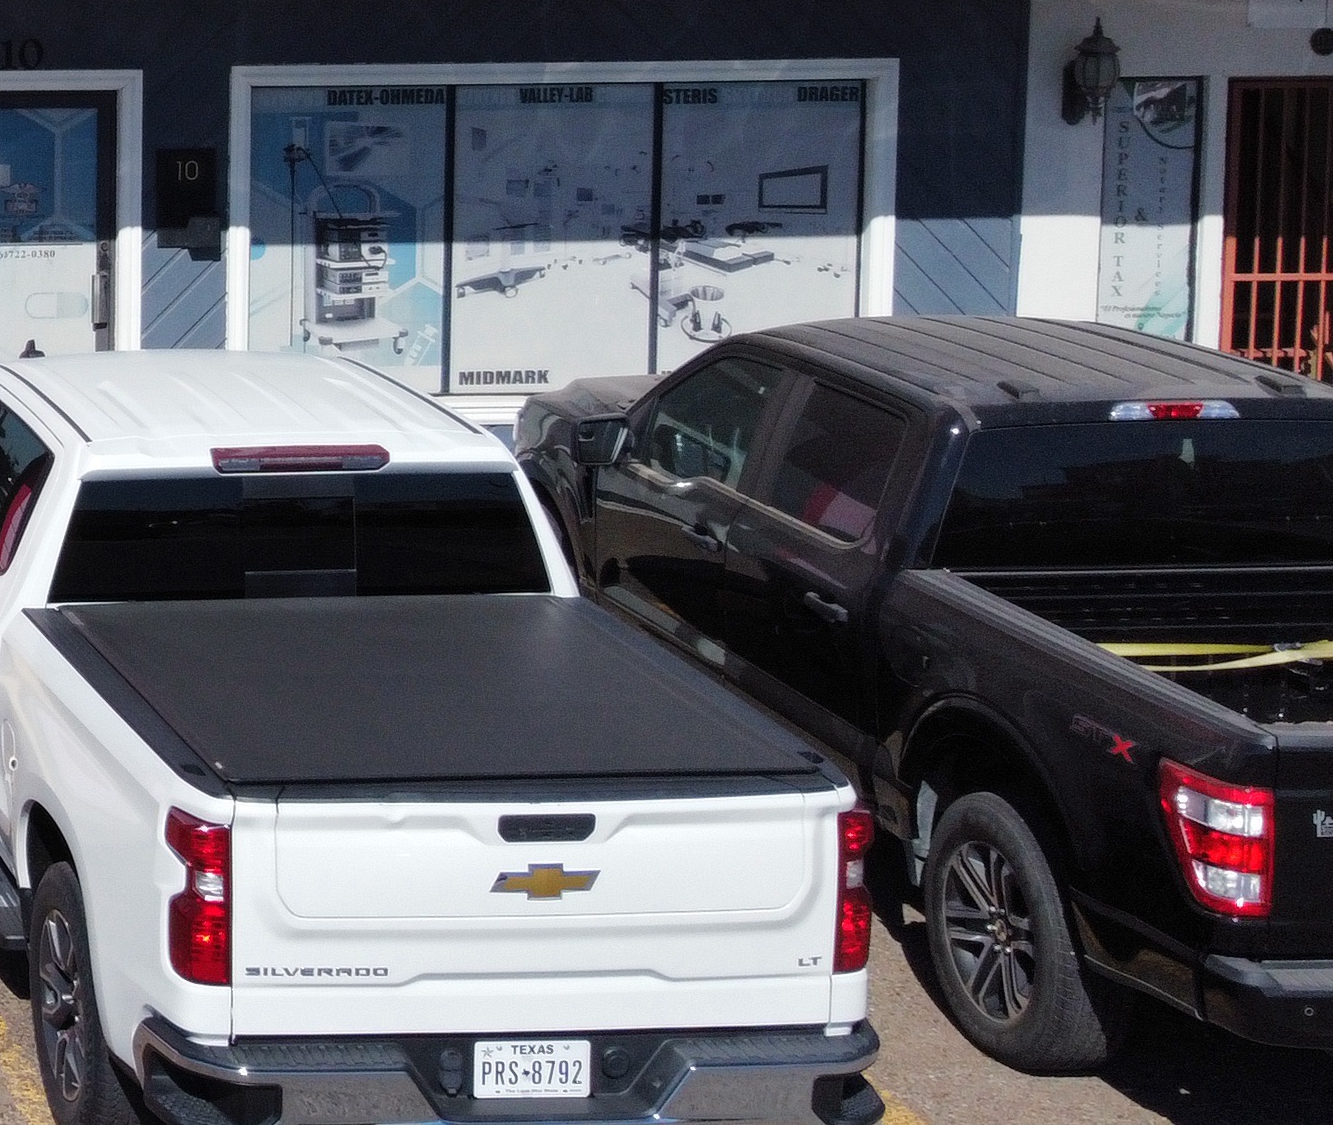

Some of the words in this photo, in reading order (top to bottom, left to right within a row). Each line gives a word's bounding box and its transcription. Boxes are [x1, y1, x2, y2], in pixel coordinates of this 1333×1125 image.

[0, 39, 44, 70] 10
[326, 88, 445, 106] DATEX-OHMEDA
[519, 86, 594, 104] VALLEY-LAB
[663, 87, 718, 105] STERIS
[797, 86, 860, 103] DRAGER
[176, 160, 199, 181] 10
[459, 370, 550, 385] MIDMARK
[797, 956, 823, 967] LT
[245, 966, 389, 978] SILVERADO
[510, 1044, 554, 1055] TEXAS
